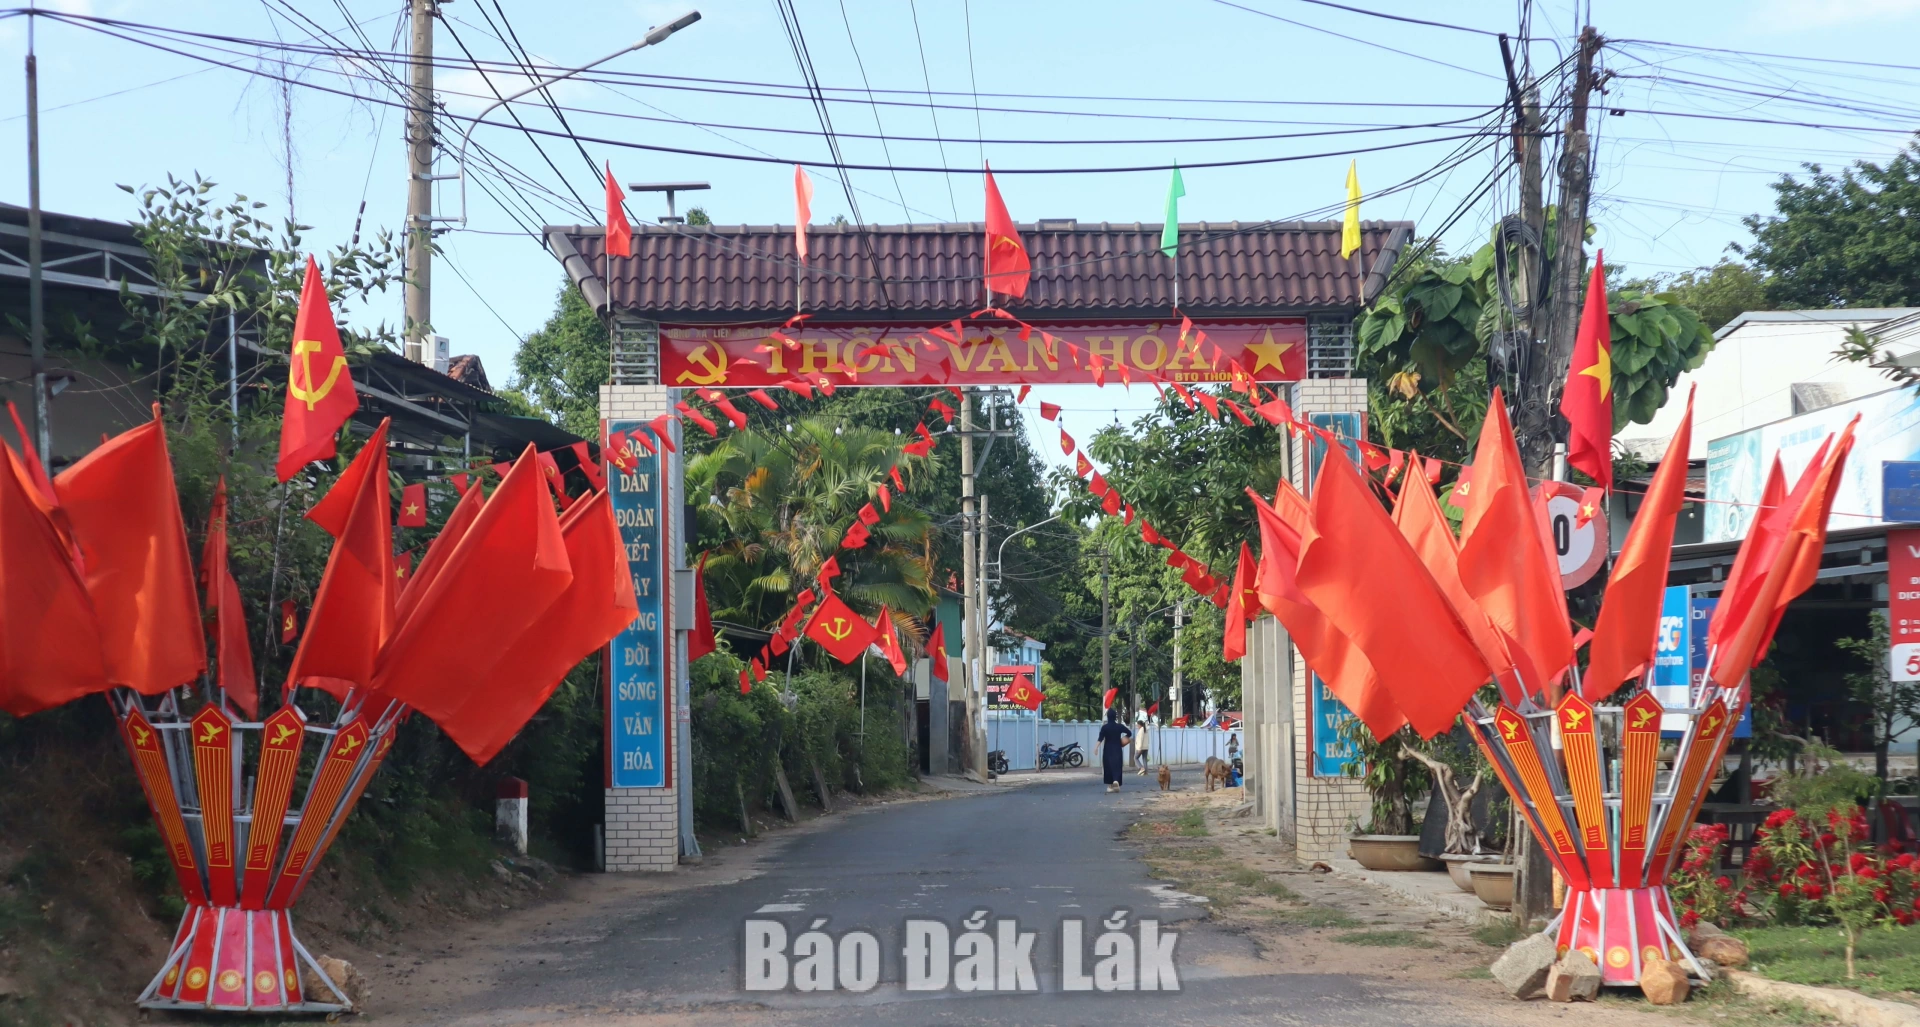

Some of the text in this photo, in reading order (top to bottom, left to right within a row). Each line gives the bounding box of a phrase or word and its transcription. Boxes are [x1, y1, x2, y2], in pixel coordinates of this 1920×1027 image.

[760, 322, 1210, 374] THÔN VĂN HÓA
[620, 469, 650, 492] DÂN
[616, 503, 655, 528] ĐOÀN
[633, 573, 651, 597] ÂY
[624, 642, 651, 666] ĐỜI
[618, 673, 657, 701] SỐNG
[623, 712, 653, 736] VĂN
[622, 746, 654, 771] HÓA
